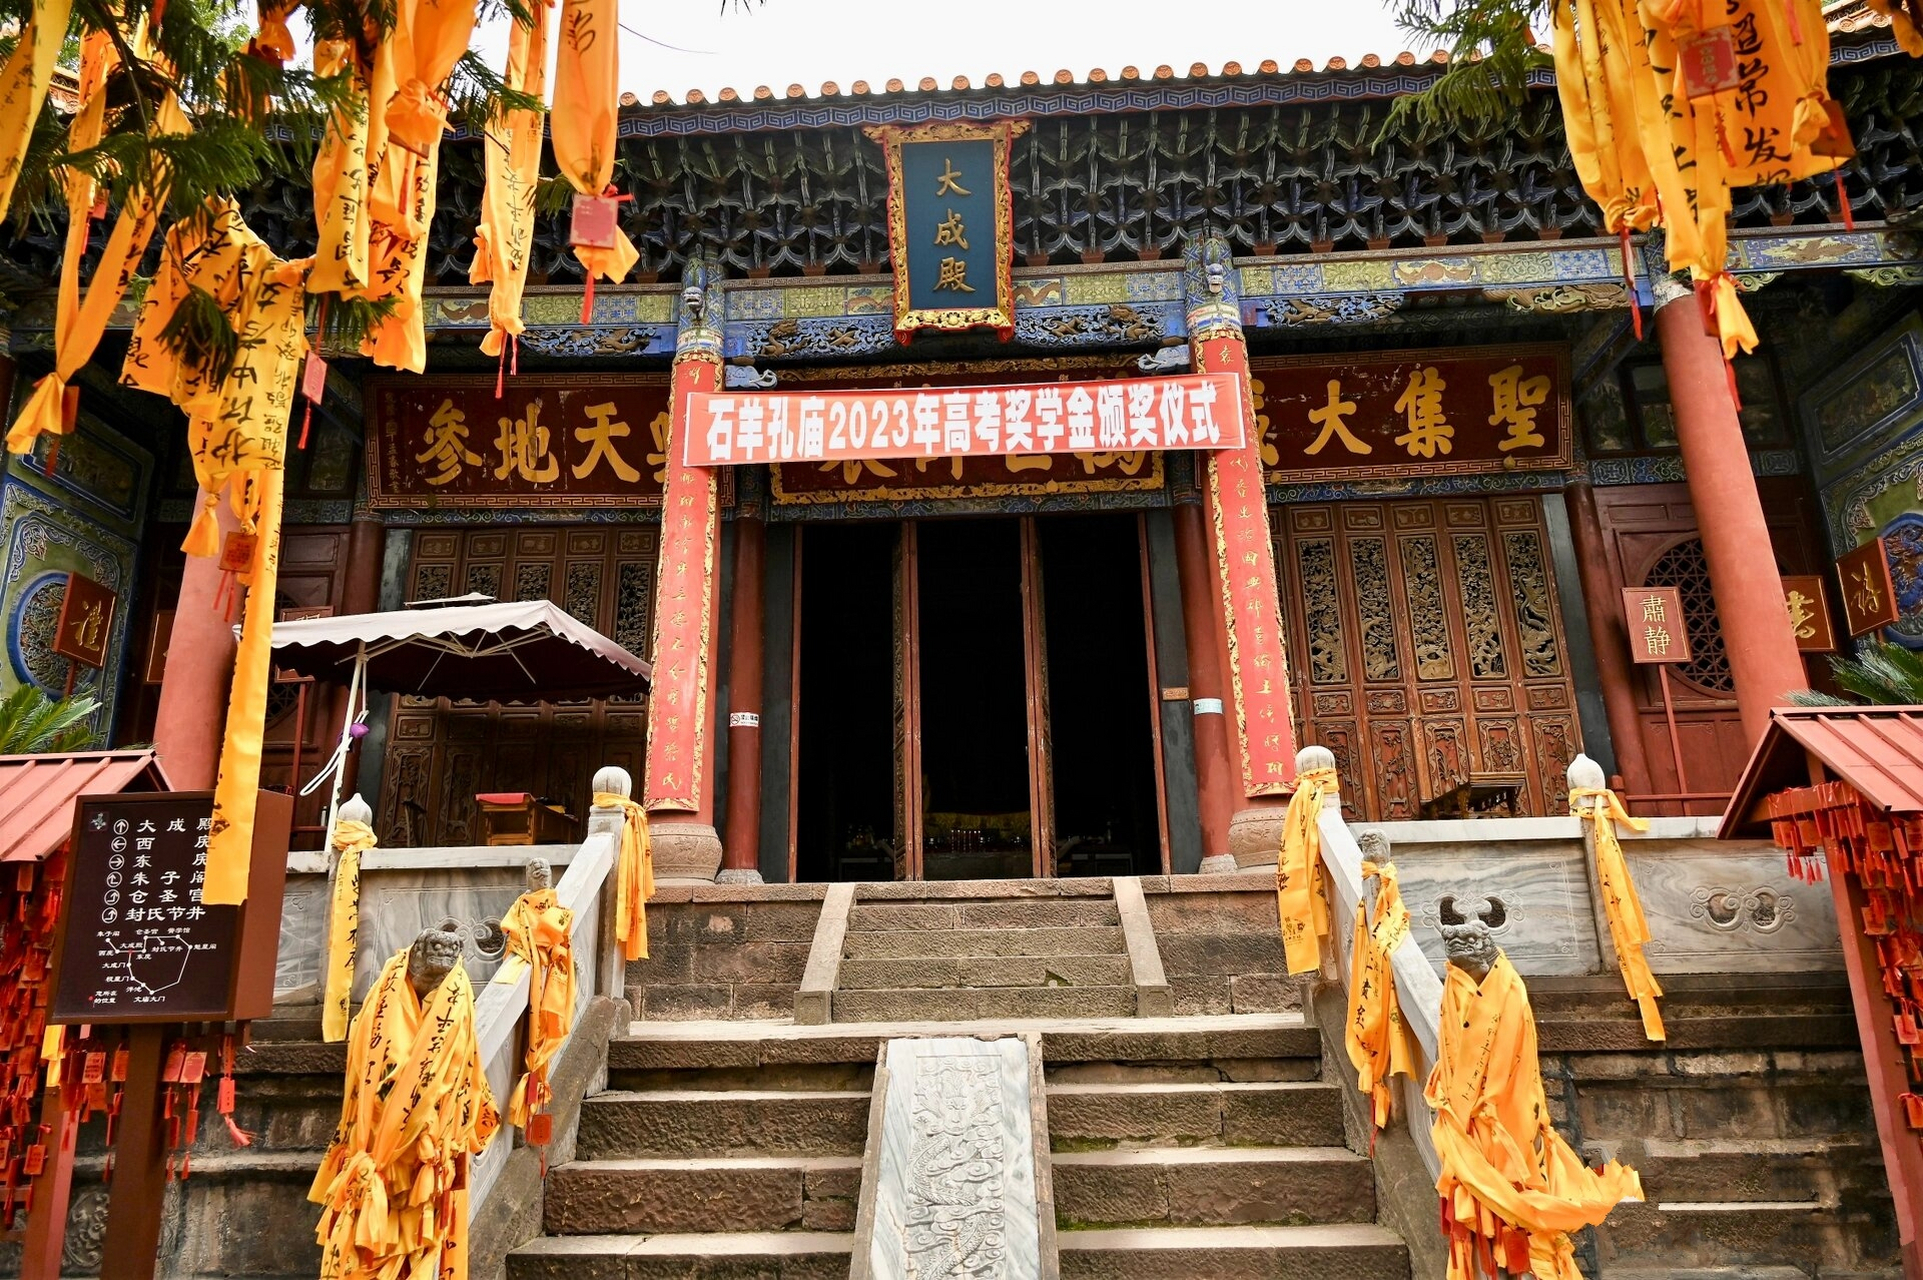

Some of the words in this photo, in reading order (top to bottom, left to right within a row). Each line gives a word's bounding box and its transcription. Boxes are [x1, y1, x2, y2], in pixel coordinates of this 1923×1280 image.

[1726, 0, 1793, 185] 超常发
[932, 157, 976, 293] 大成殿
[706, 380, 1221, 462] 石羊孔庙2023年高考奖学金颁奖仪式
[136, 817, 212, 833] 大成殿
[130, 871, 206, 886] 朱子阁
[128, 888, 203, 904] 仓圣宫
[125, 906, 206, 922] 封氏节井
